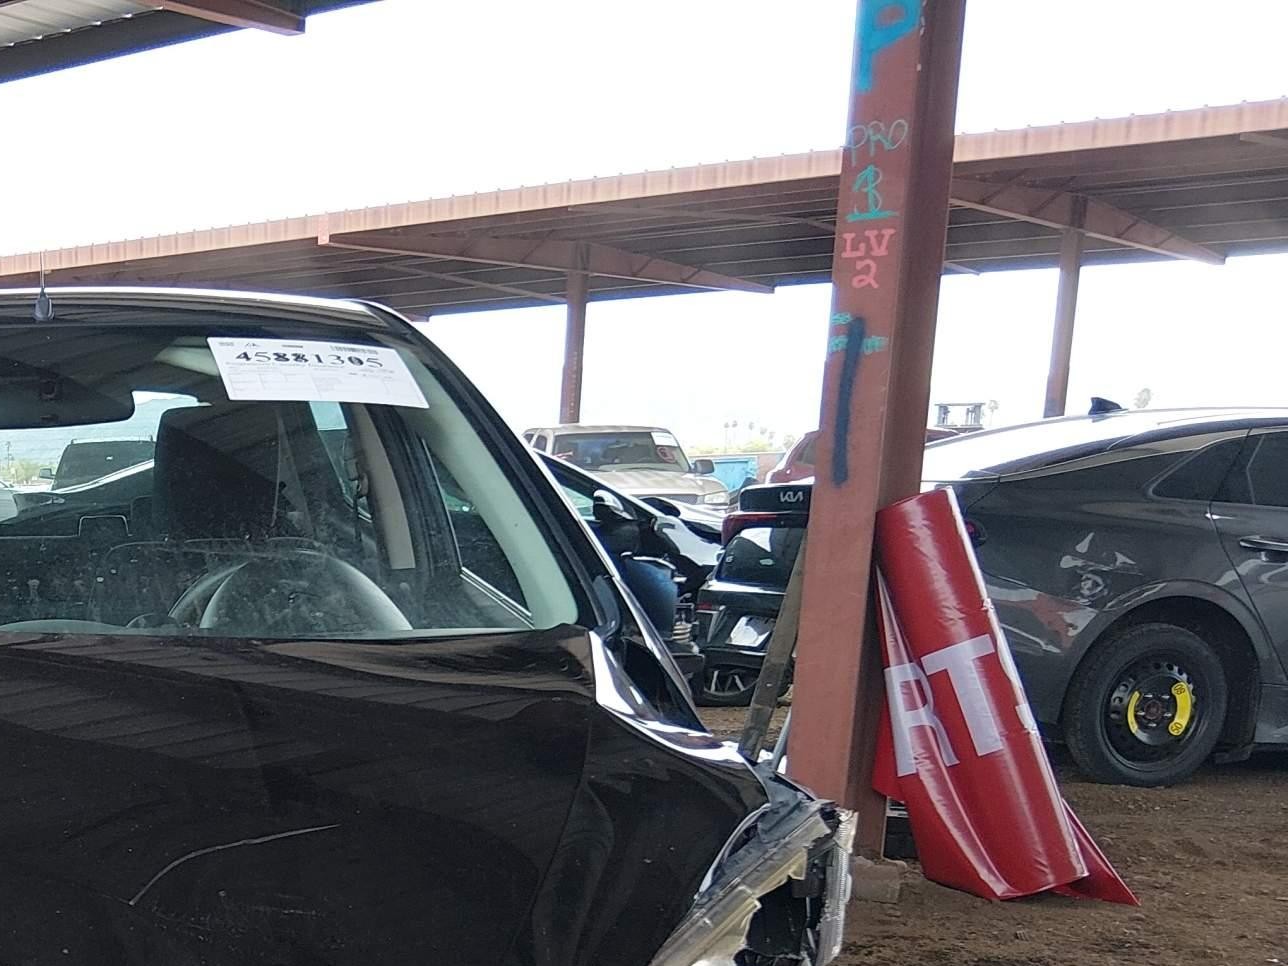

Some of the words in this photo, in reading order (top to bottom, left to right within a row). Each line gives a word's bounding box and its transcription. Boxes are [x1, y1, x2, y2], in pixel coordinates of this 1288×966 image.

[841, 228, 896, 258] LV
[852, 260, 880, 289] 2
[235, 351, 384, 369] 45881305
[884, 634, 1036, 777] RT
